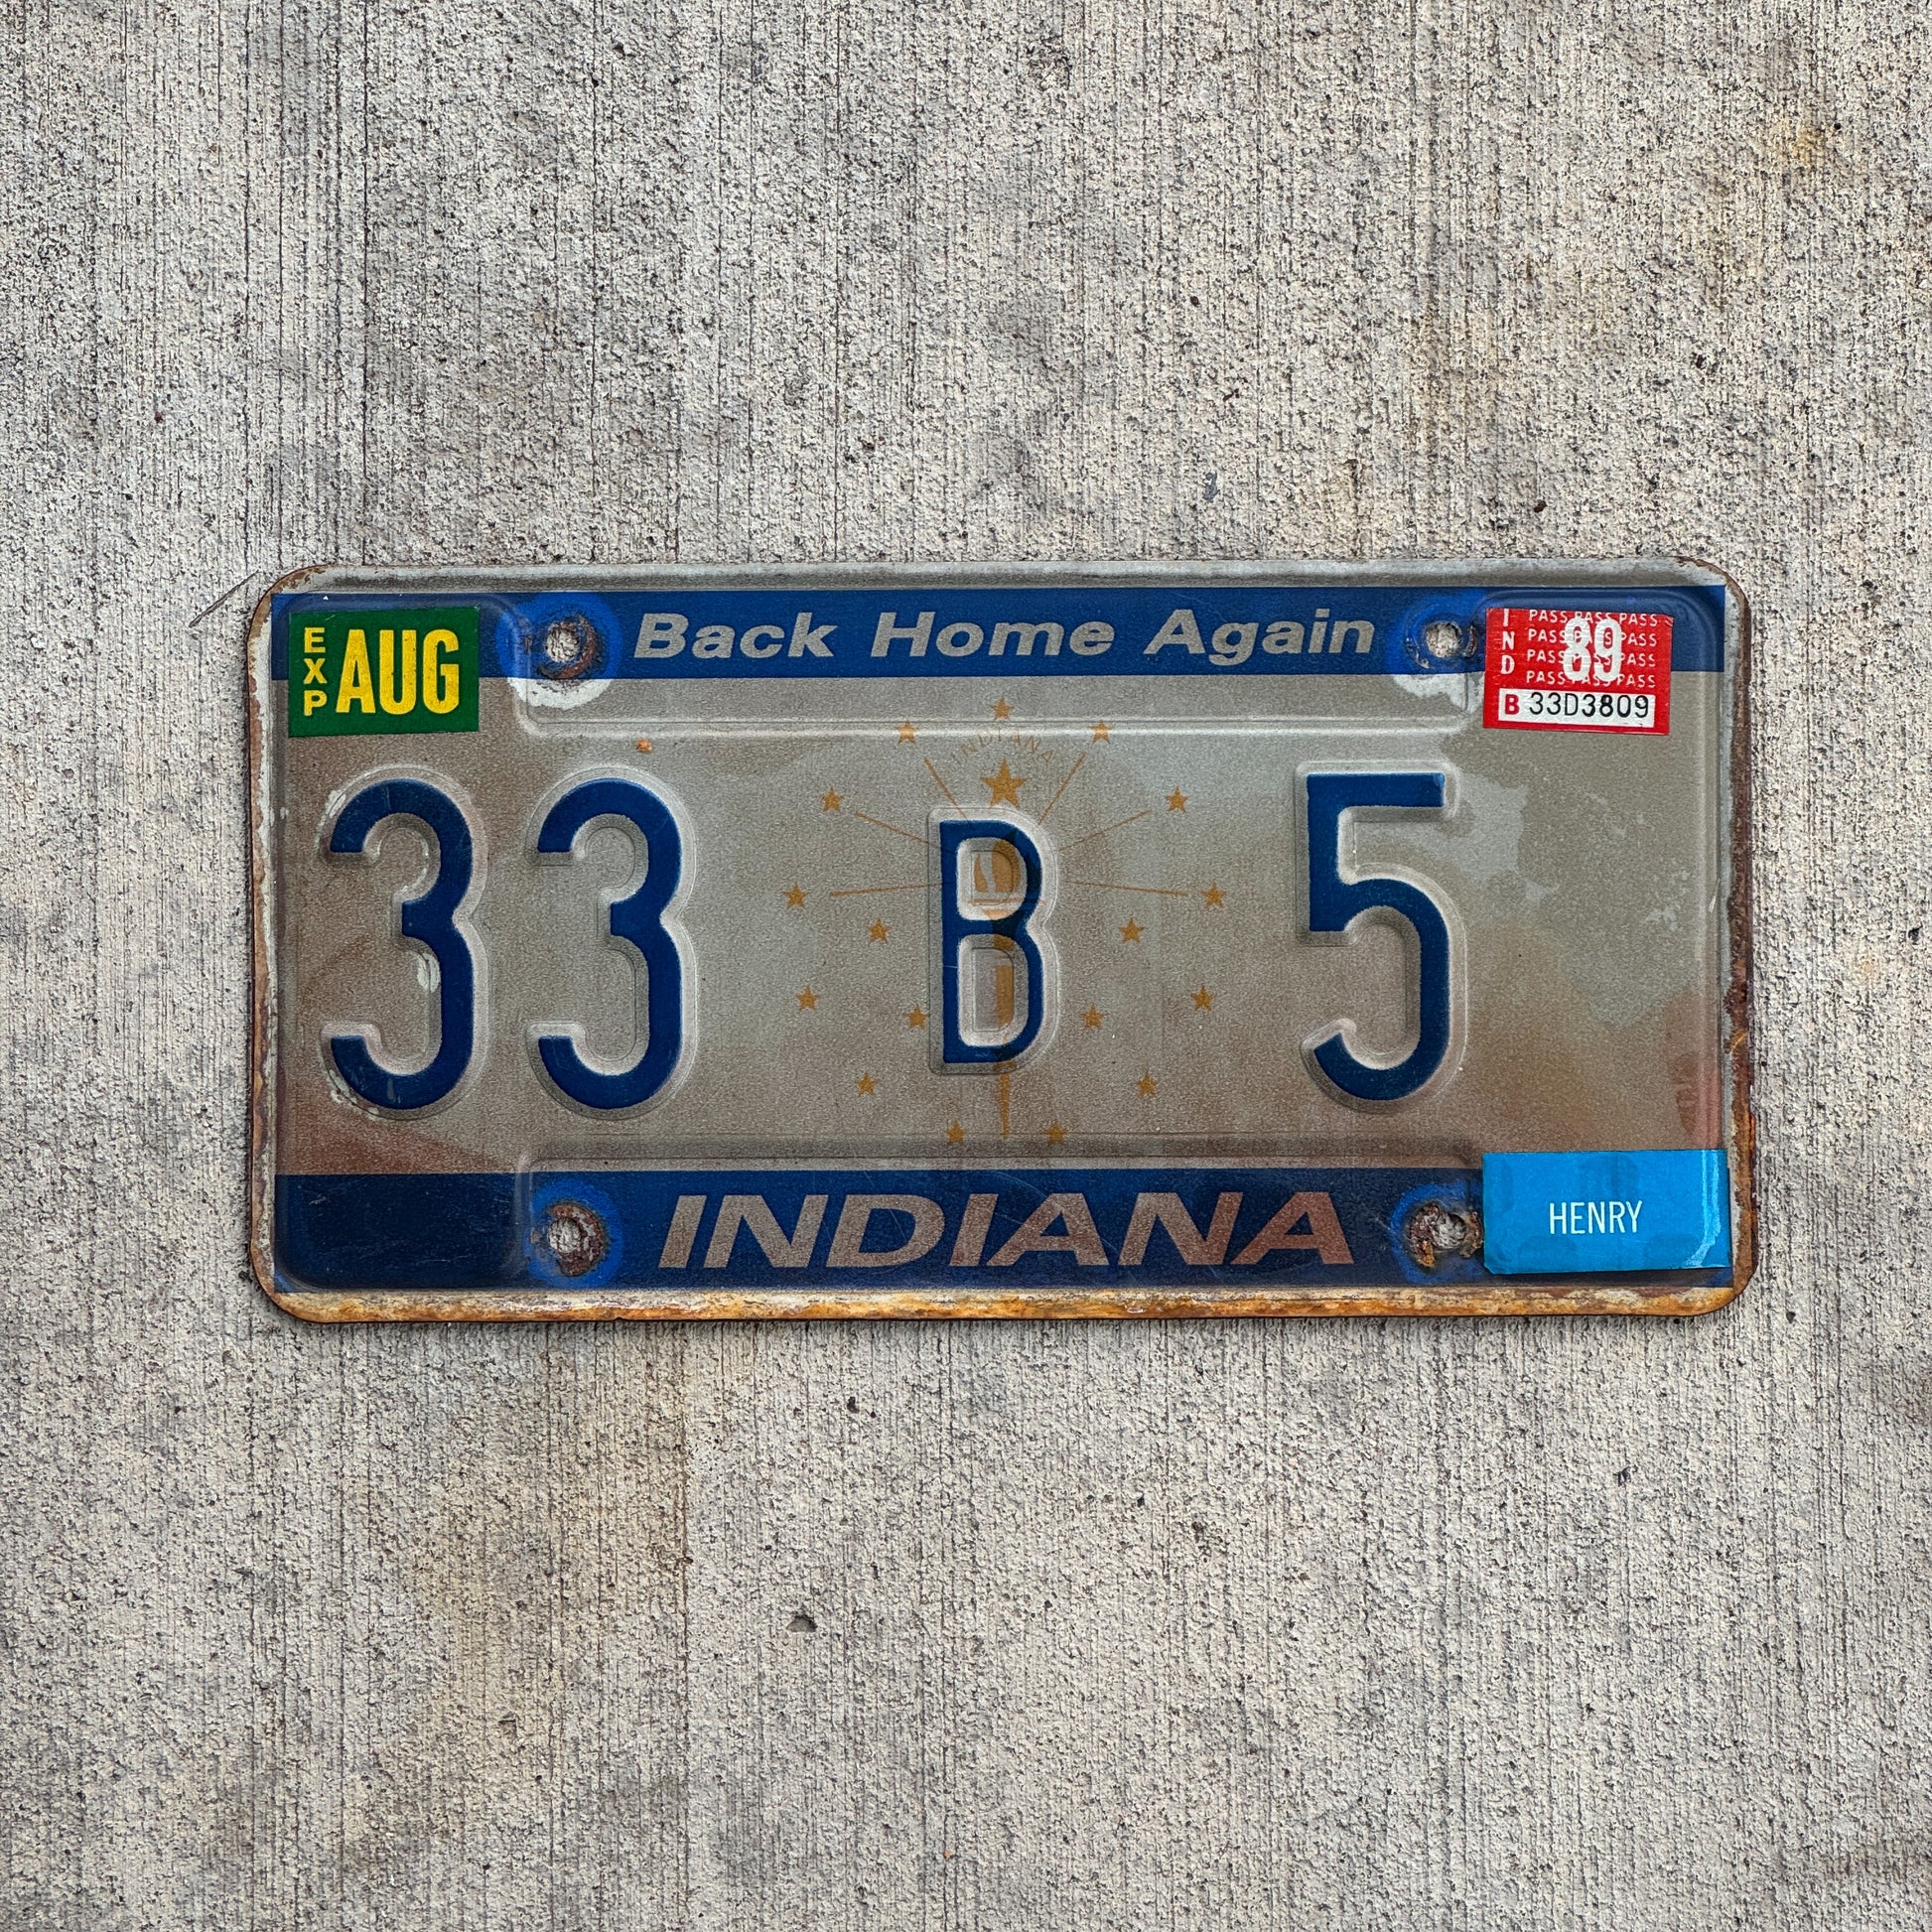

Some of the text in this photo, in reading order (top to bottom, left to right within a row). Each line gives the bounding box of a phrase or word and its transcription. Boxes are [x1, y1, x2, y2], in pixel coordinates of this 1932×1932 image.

[633, 609, 1376, 666] Back Home Again
[1500, 608, 1515, 675] IND
[1528, 609, 1568, 623] PASS
[1619, 613, 1658, 627] PASS
[1528, 628, 1566, 643] PASS
[303, 626, 328, 716] EXP
[336, 629, 460, 715] AUG
[1527, 648, 1565, 664] PASS
[1563, 617, 1622, 681] 89
[1504, 692, 1649, 718] B 33D3809
[1526, 670, 1566, 685] PASS
[1617, 673, 1656, 688] PASS
[330, 772, 1450, 1110] 33 B 5
[658, 1191, 1354, 1269] INDIANA
[1549, 1200, 1643, 1235] HENRY
